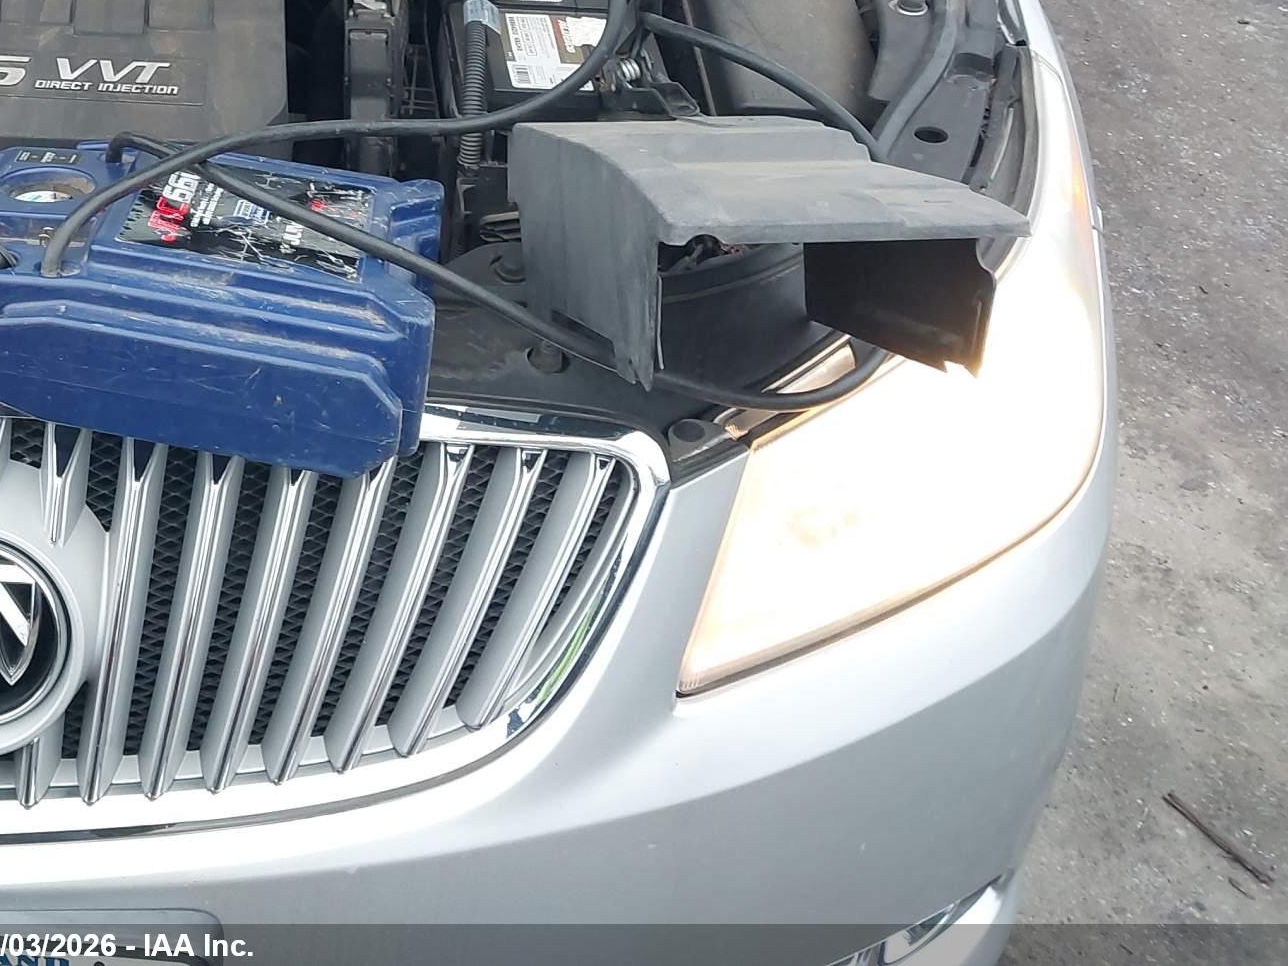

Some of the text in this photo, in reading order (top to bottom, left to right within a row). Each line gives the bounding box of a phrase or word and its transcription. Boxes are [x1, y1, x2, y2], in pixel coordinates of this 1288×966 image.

[56, 57, 171, 84] VVT
[34, 79, 179, 96] DIRECT INJECTION
